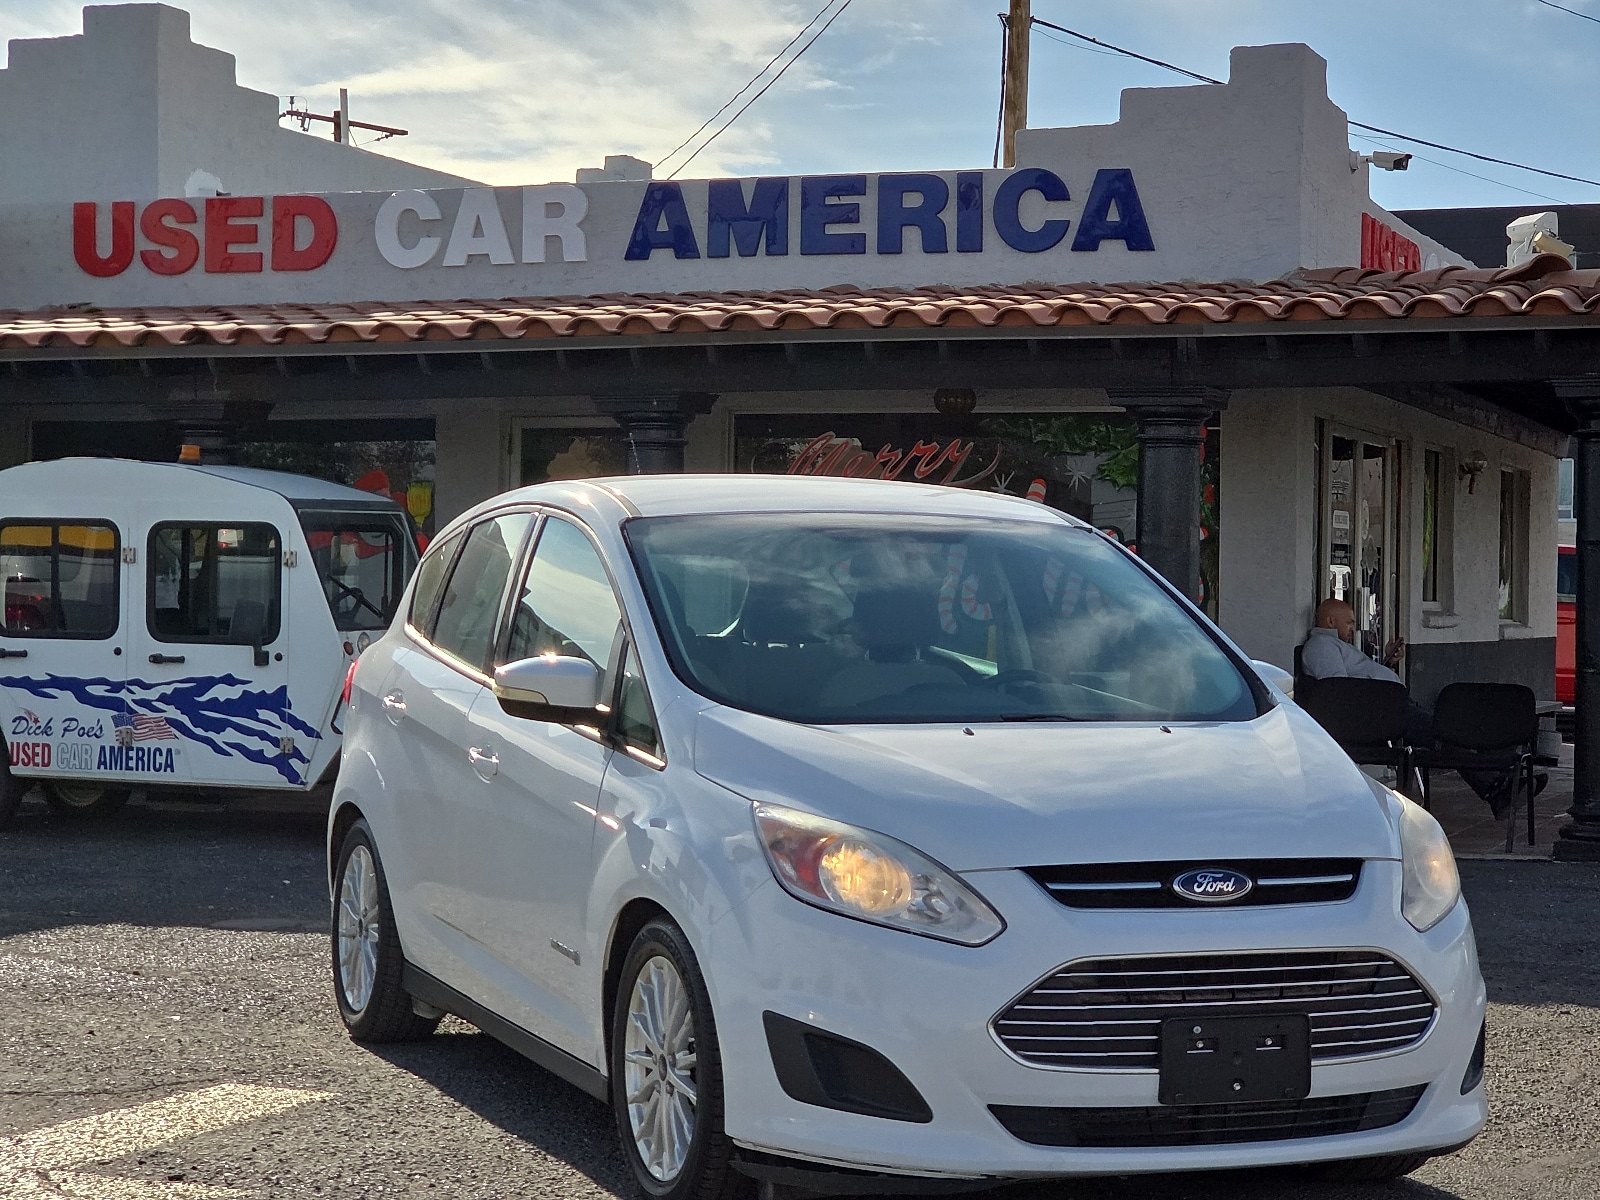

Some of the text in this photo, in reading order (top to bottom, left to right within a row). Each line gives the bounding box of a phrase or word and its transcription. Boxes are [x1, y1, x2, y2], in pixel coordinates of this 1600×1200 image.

[73, 167, 1156, 278] USED CAR AMERICA
[786, 431, 976, 485] Merry
[11, 715, 105, 739] Dick Poe's
[10, 741, 175, 773] USED CAR AMERICA
[1193, 872, 1236, 893] Ford
